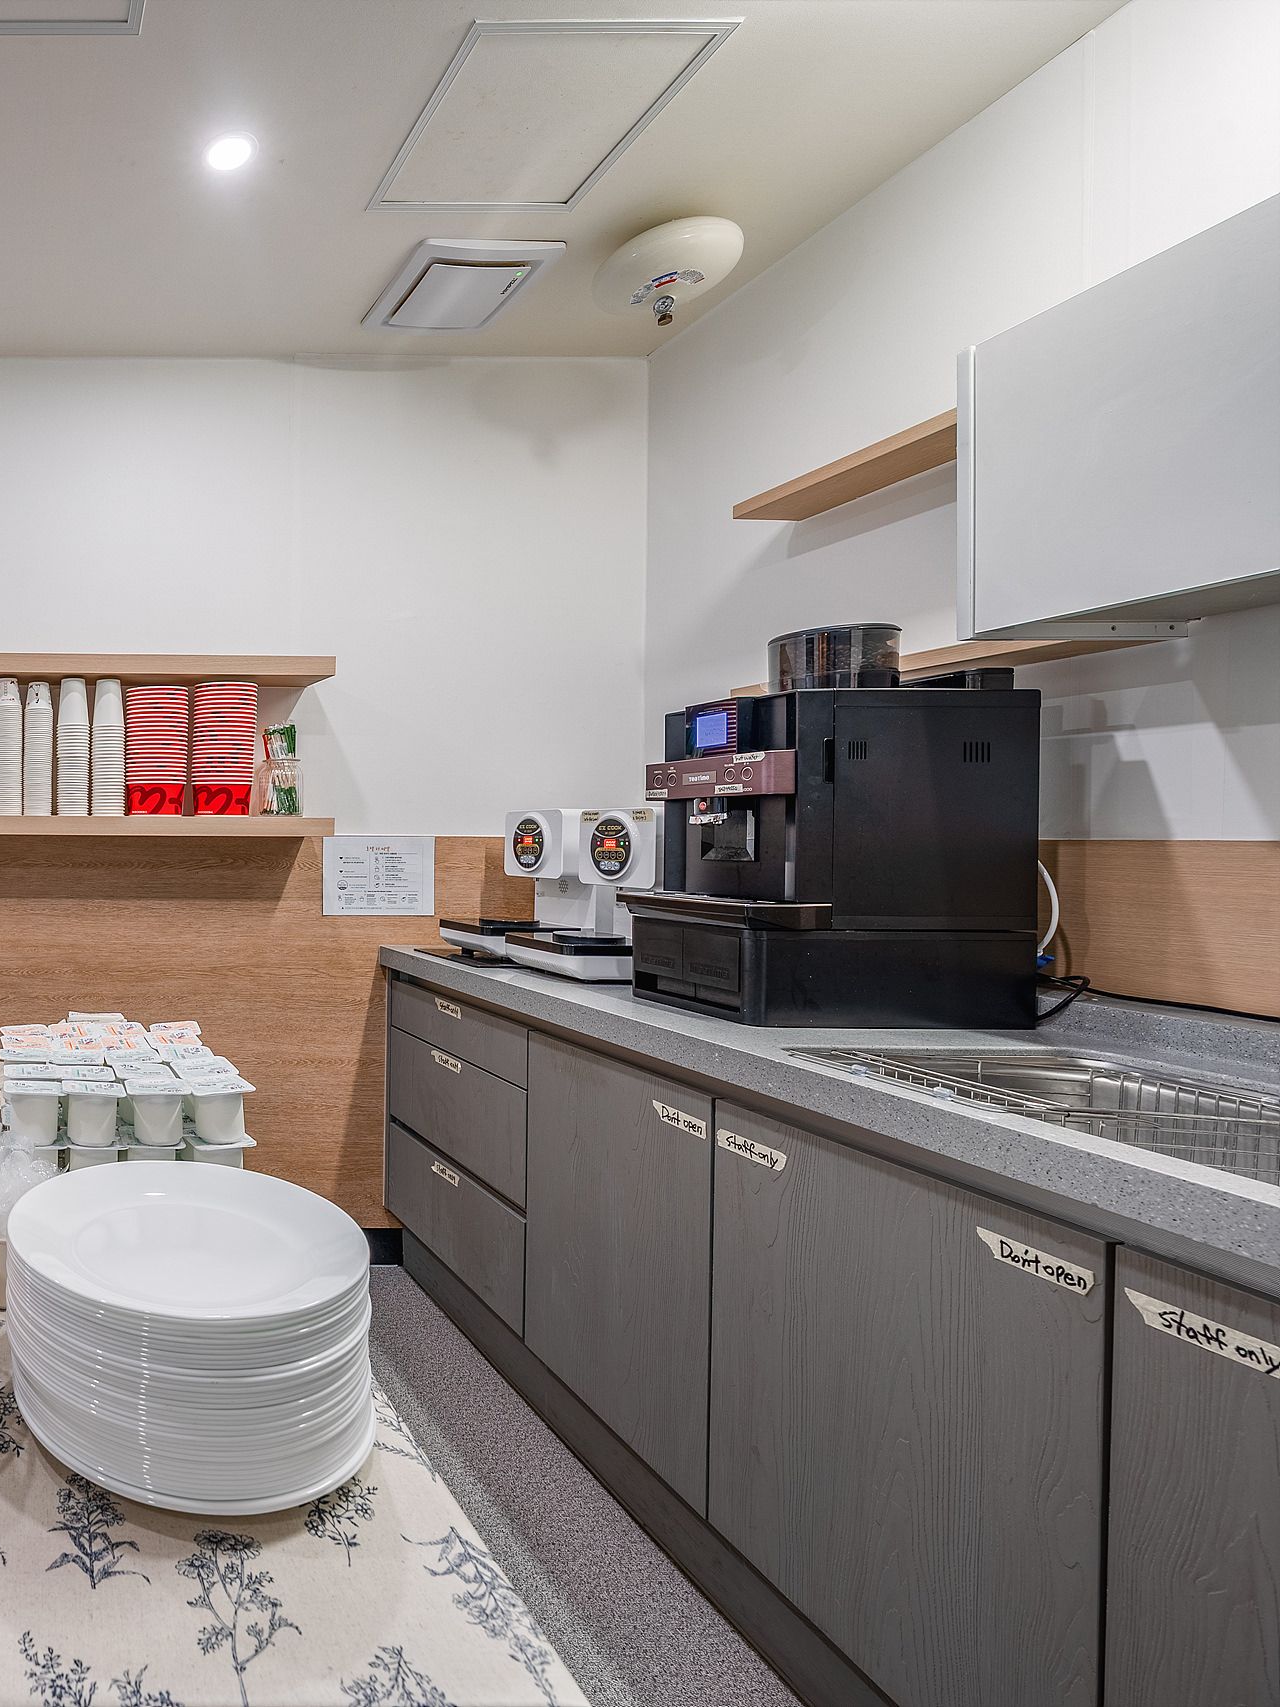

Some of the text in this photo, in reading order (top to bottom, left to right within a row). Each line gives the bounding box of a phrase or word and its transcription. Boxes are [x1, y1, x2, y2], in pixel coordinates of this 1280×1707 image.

[683, 1119, 703, 1136] open
[757, 1152, 779, 1169] only
[999, 1239, 1087, 1291] Don't open
[1235, 1342, 1280, 1375] only
